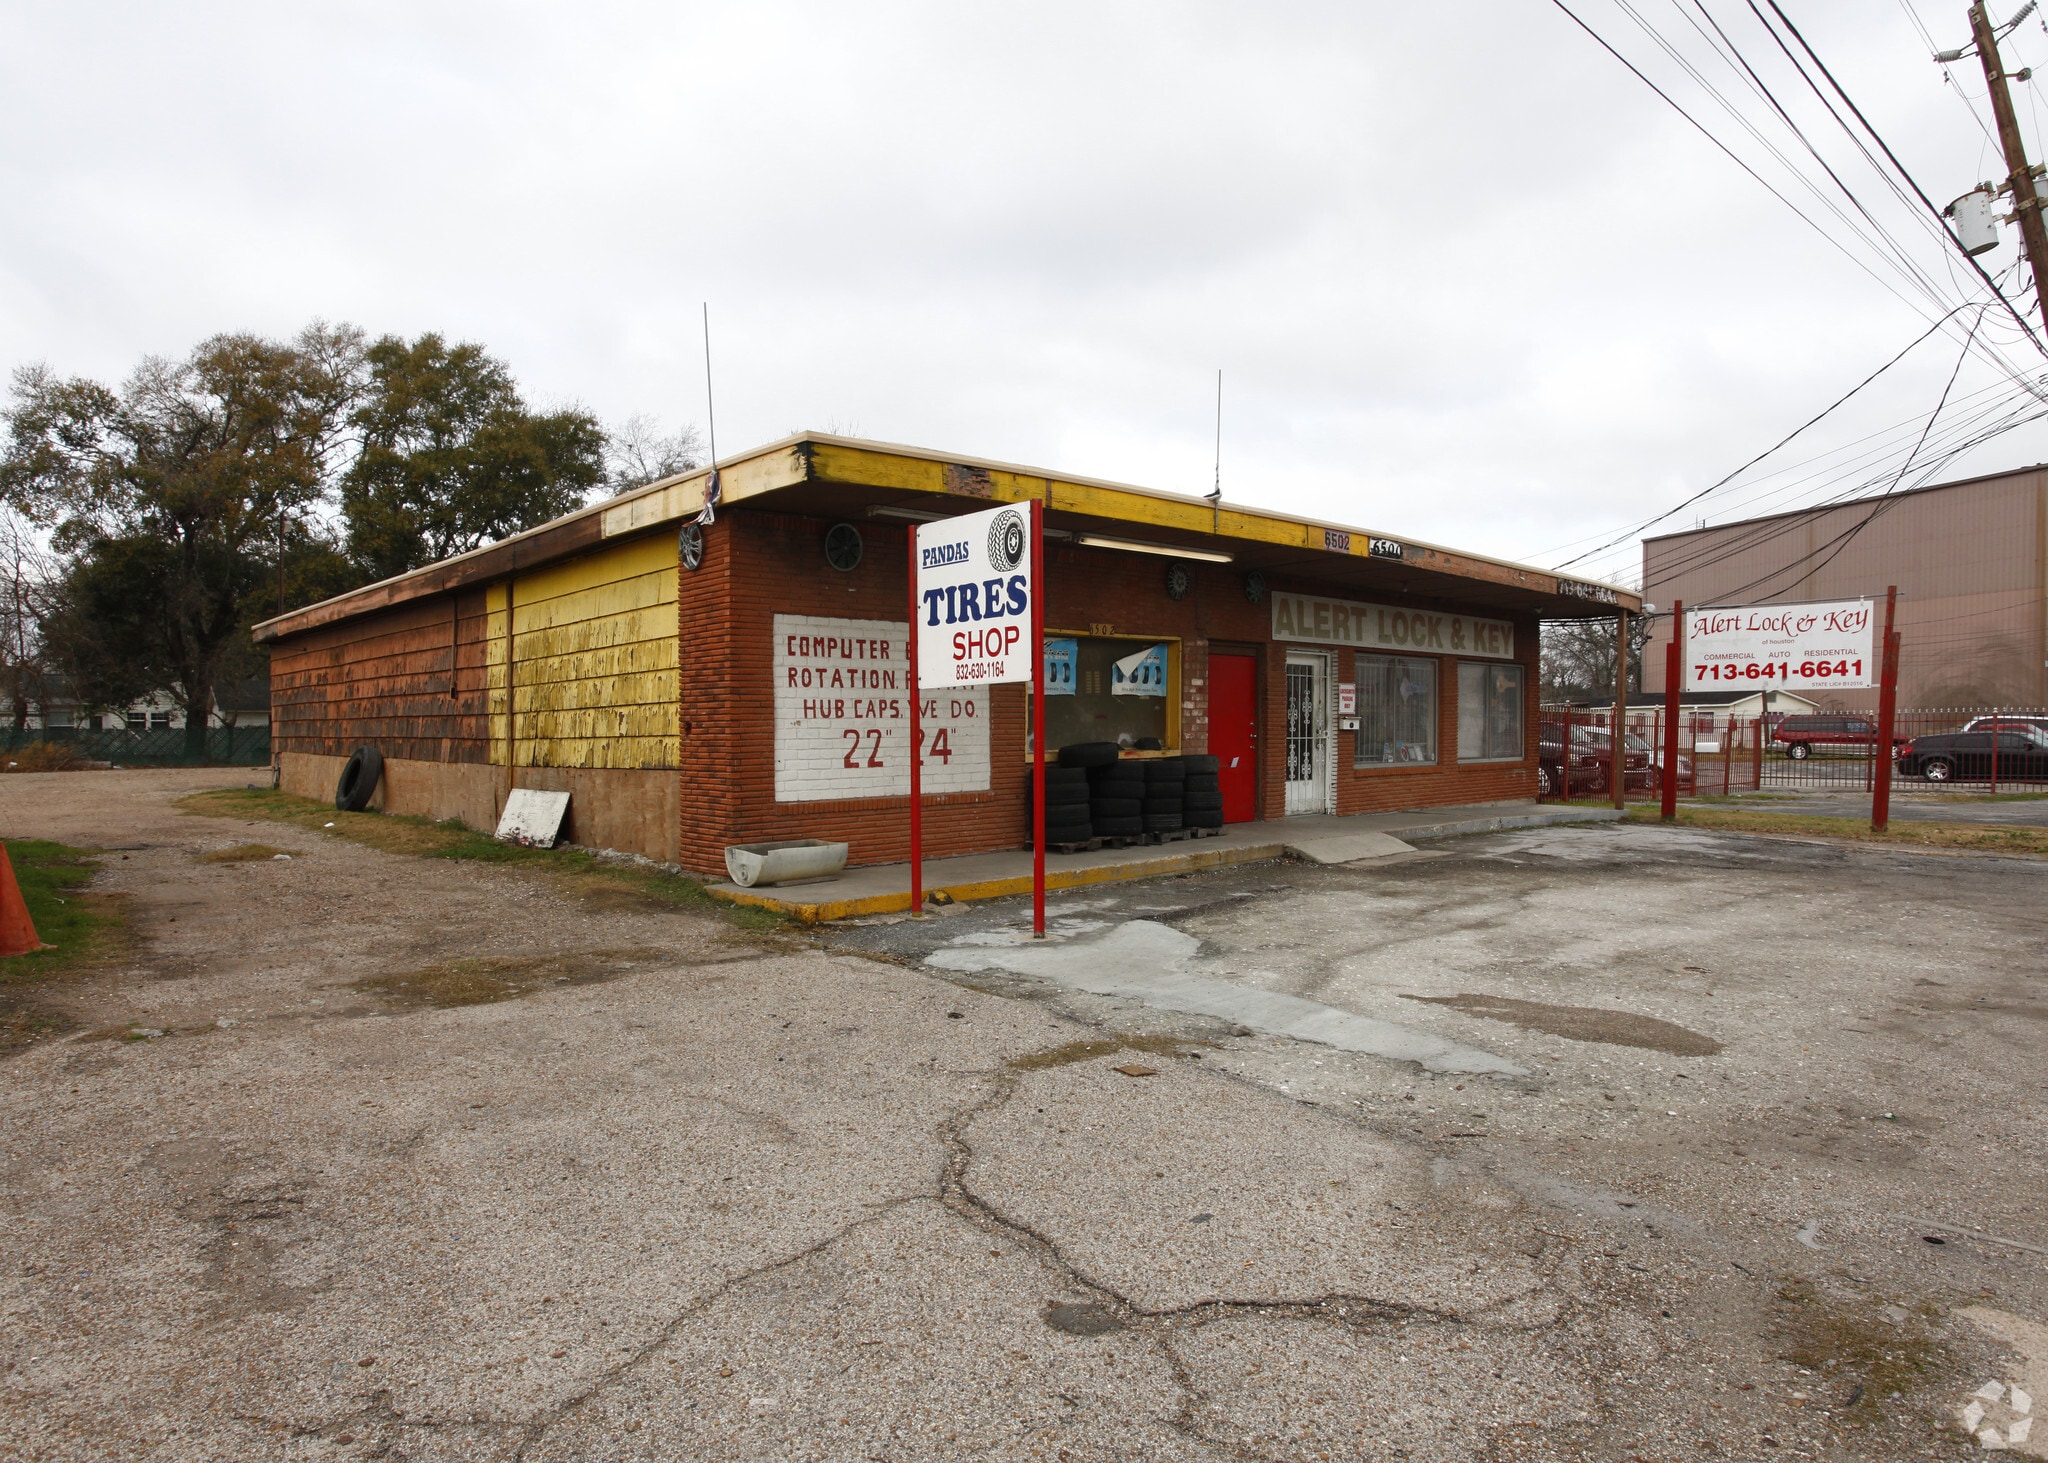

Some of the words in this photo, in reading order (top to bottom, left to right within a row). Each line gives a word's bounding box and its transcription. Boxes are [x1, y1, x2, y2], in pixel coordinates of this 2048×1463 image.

[1325, 531, 1349, 551] 6502
[922, 540, 969, 567] PANDAS
[923, 575, 1028, 627] TIRES
[1274, 598, 1367, 642] ALERT
[1377, 609, 1443, 649] LOCK
[1451, 617, 1466, 650] &
[1473, 621, 1513, 655] KEY
[1690, 612, 1741, 640] Alert
[1746, 611, 1798, 638] Lock
[1797, 613, 1818, 633] &
[1823, 608, 1869, 634] Key
[787, 635, 890, 660] COMPUTER
[952, 625, 1020, 661] SHOP
[1703, 652, 1756, 661] COMMERCIAL
[1804, 648, 1858, 657] RESIDENTIAL
[788, 667, 899, 688] ROTATION.
[955, 661, 1005, 680] 832-630-1164
[1694, 659, 1862, 681] 713-641-6641
[803, 699, 844, 718] HUB
[951, 700, 979, 718] DO.
